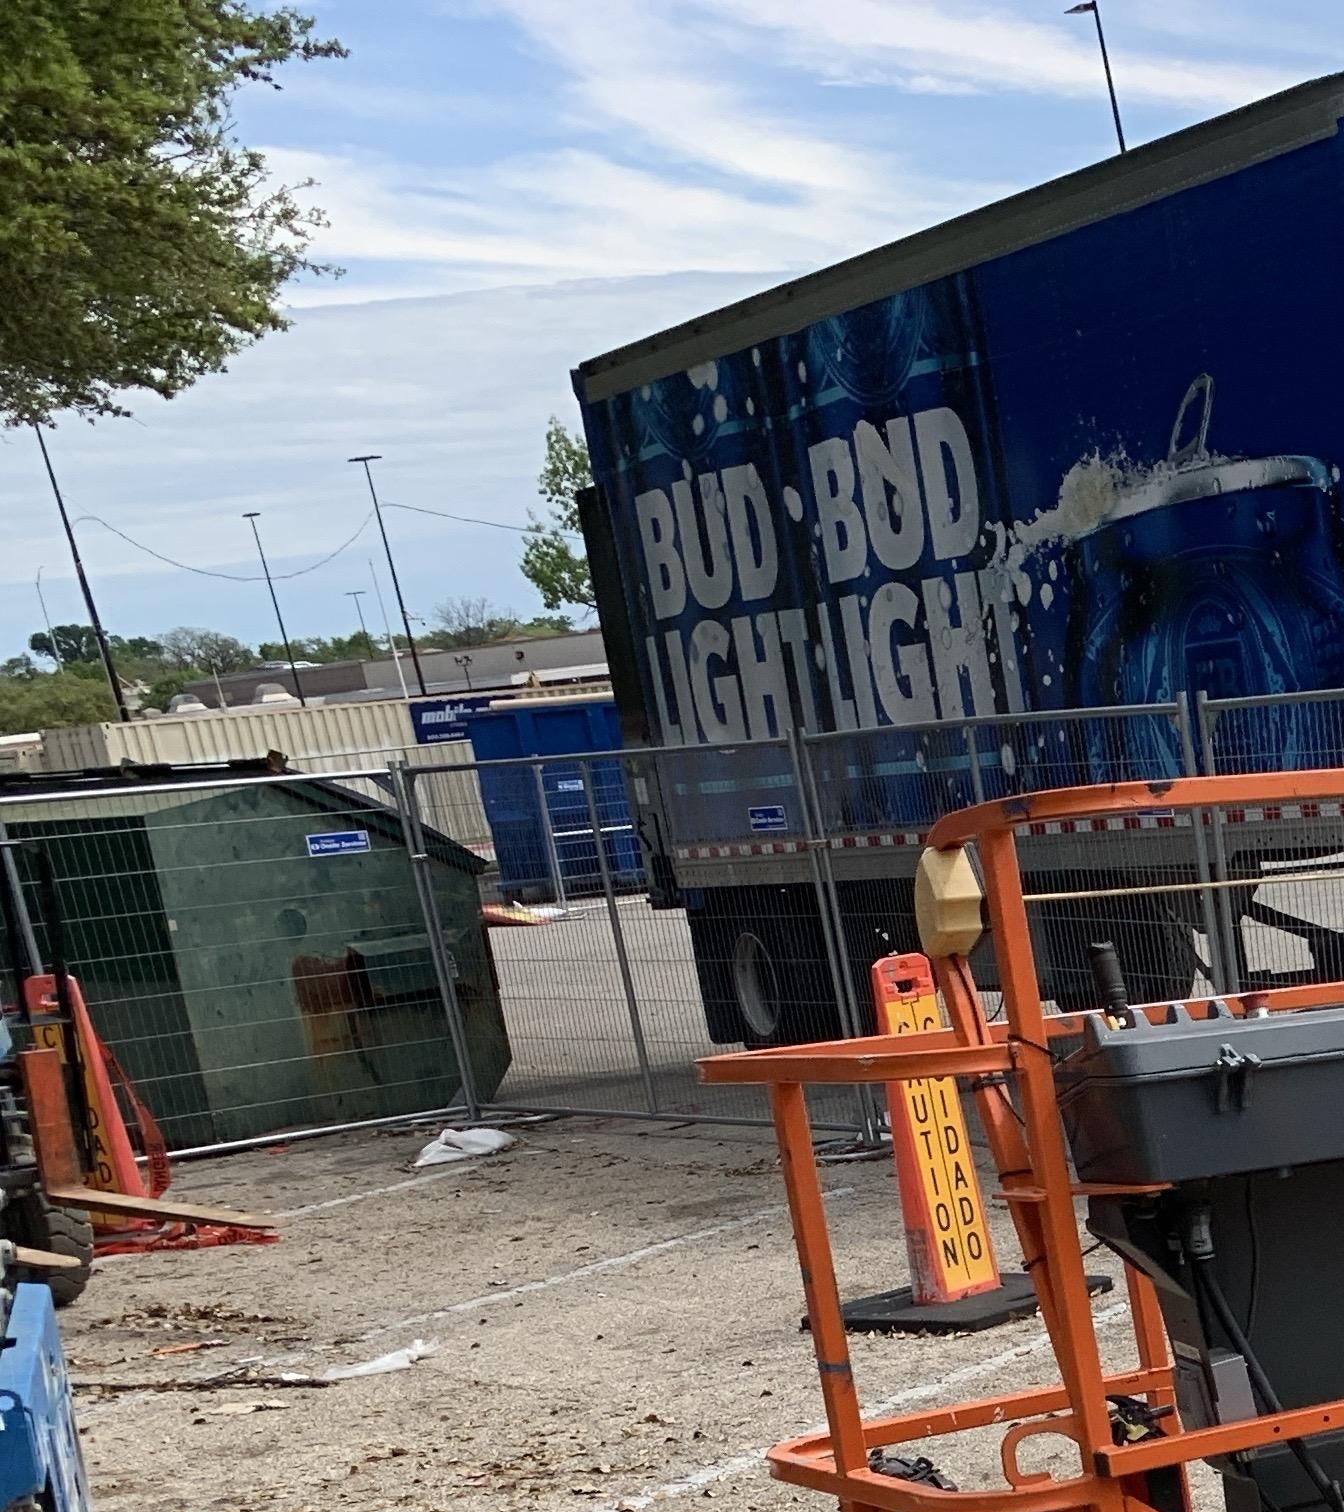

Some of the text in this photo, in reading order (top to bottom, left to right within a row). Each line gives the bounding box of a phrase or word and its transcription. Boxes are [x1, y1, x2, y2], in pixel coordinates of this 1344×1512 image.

[634, 462, 779, 620] BUD
[645, 608, 819, 746] LIGHT
[817, 568, 1024, 731] LIGHT
[897, 1021, 963, 1269] UTION
[923, 1016, 983, 1261] IDADO
